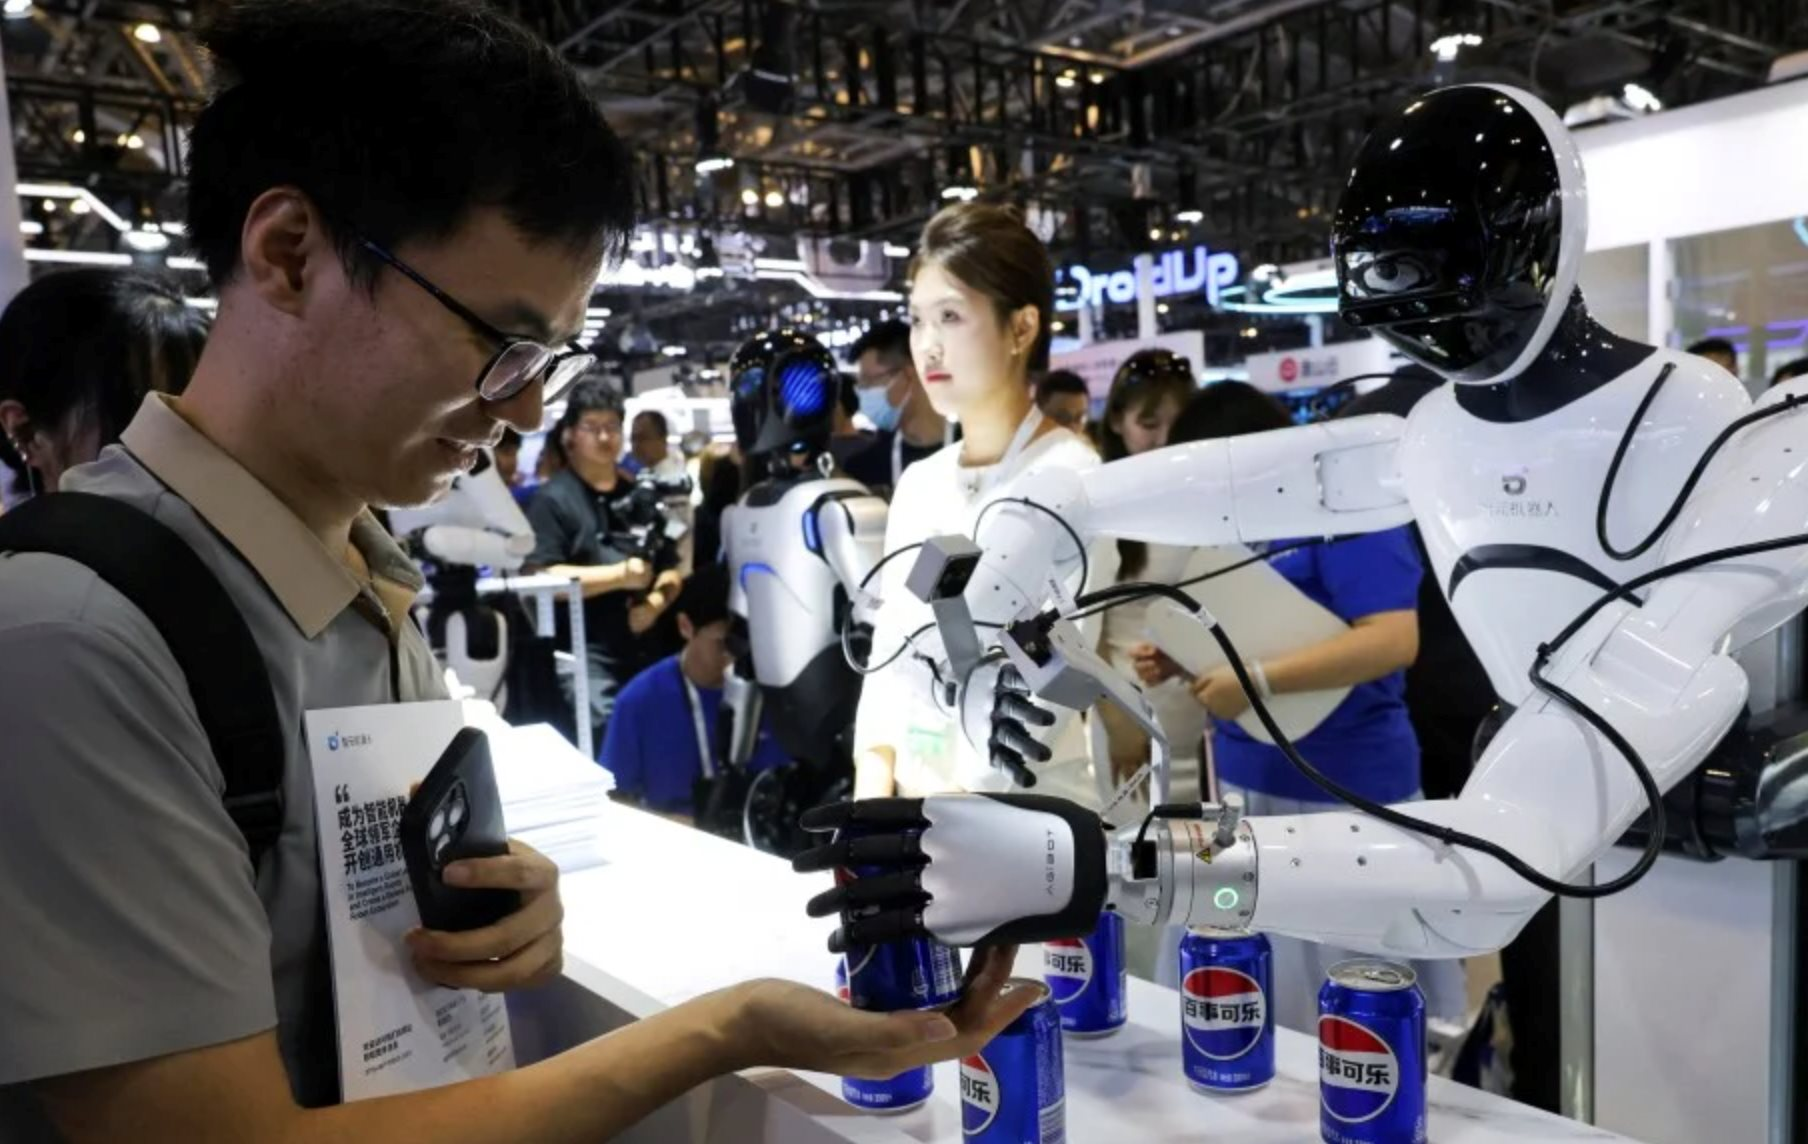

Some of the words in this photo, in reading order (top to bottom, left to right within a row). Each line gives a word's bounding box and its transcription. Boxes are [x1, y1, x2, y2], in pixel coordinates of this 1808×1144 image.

[1045, 829, 1055, 896] AGIBOT
[1184, 998, 1261, 1022] 百事可乐
[1319, 1047, 1390, 1085] 事可乐
